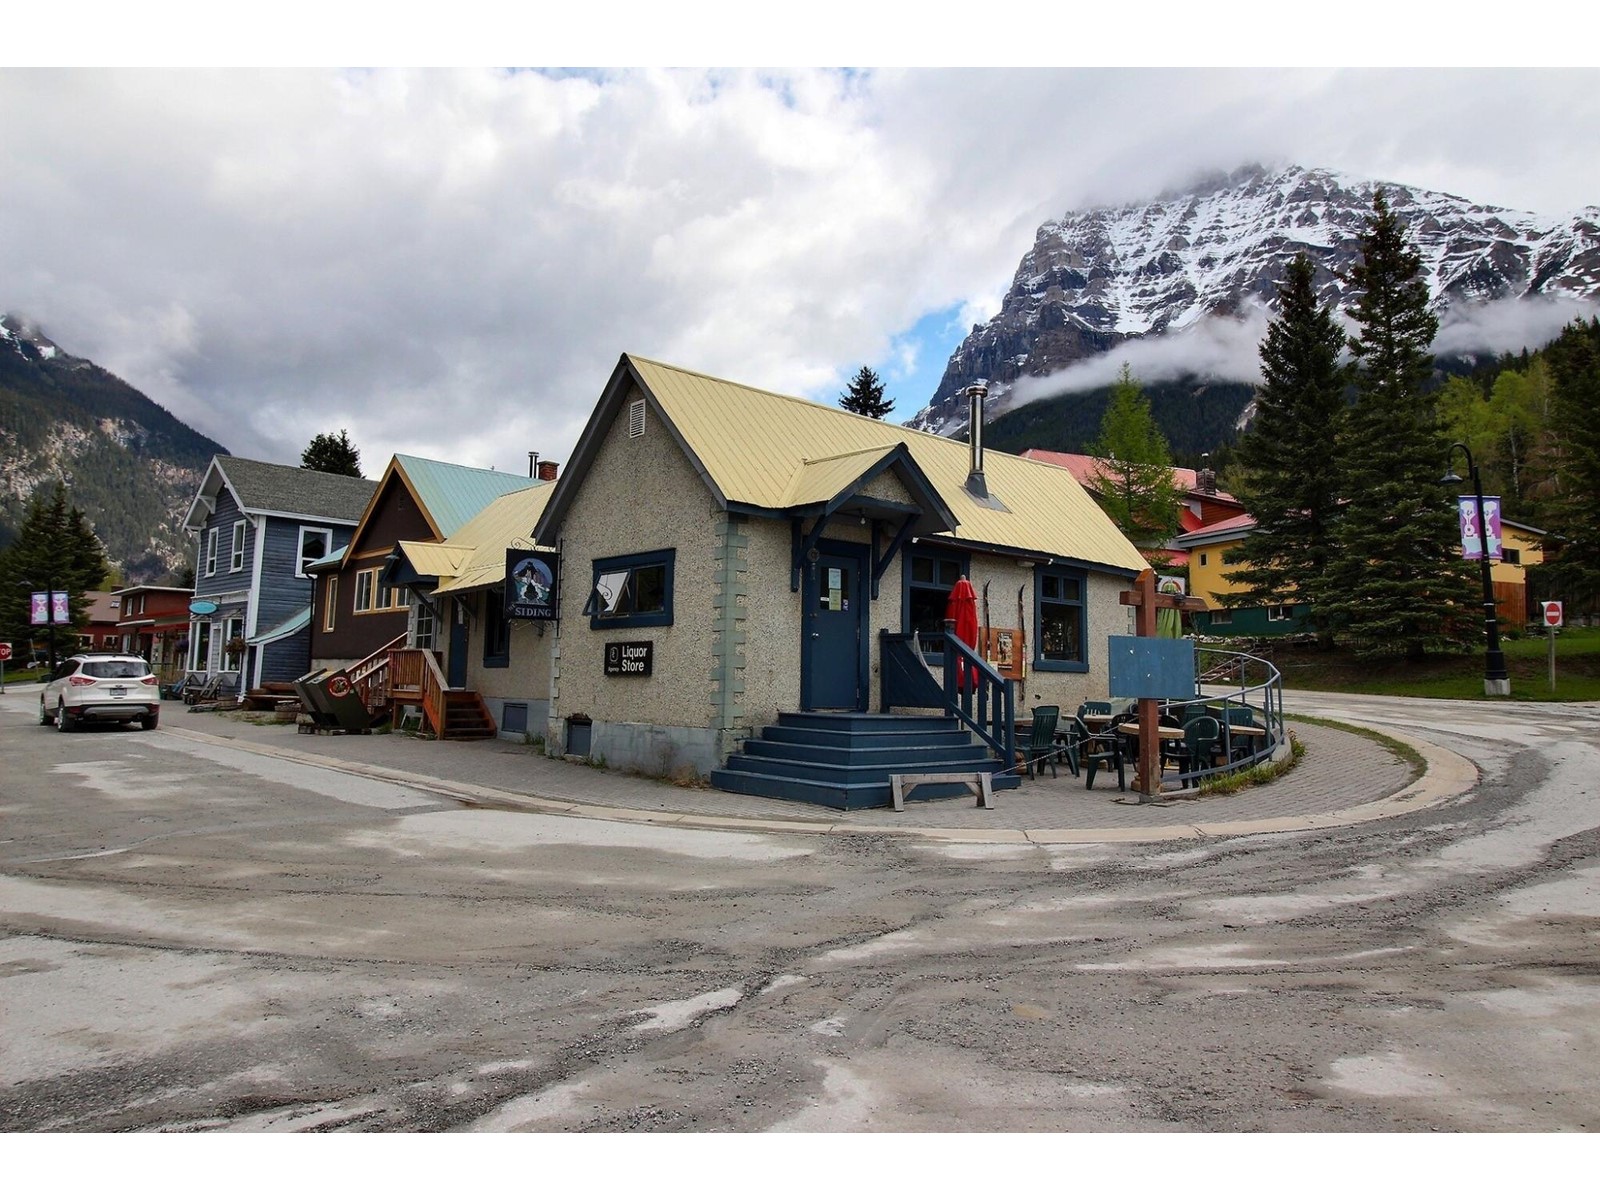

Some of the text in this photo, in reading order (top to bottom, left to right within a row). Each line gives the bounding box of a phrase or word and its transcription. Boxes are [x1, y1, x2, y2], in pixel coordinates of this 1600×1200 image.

[515, 607, 551, 617] SIDING
[622, 645, 647, 660] Liquor
[621, 659, 645, 672] Store
